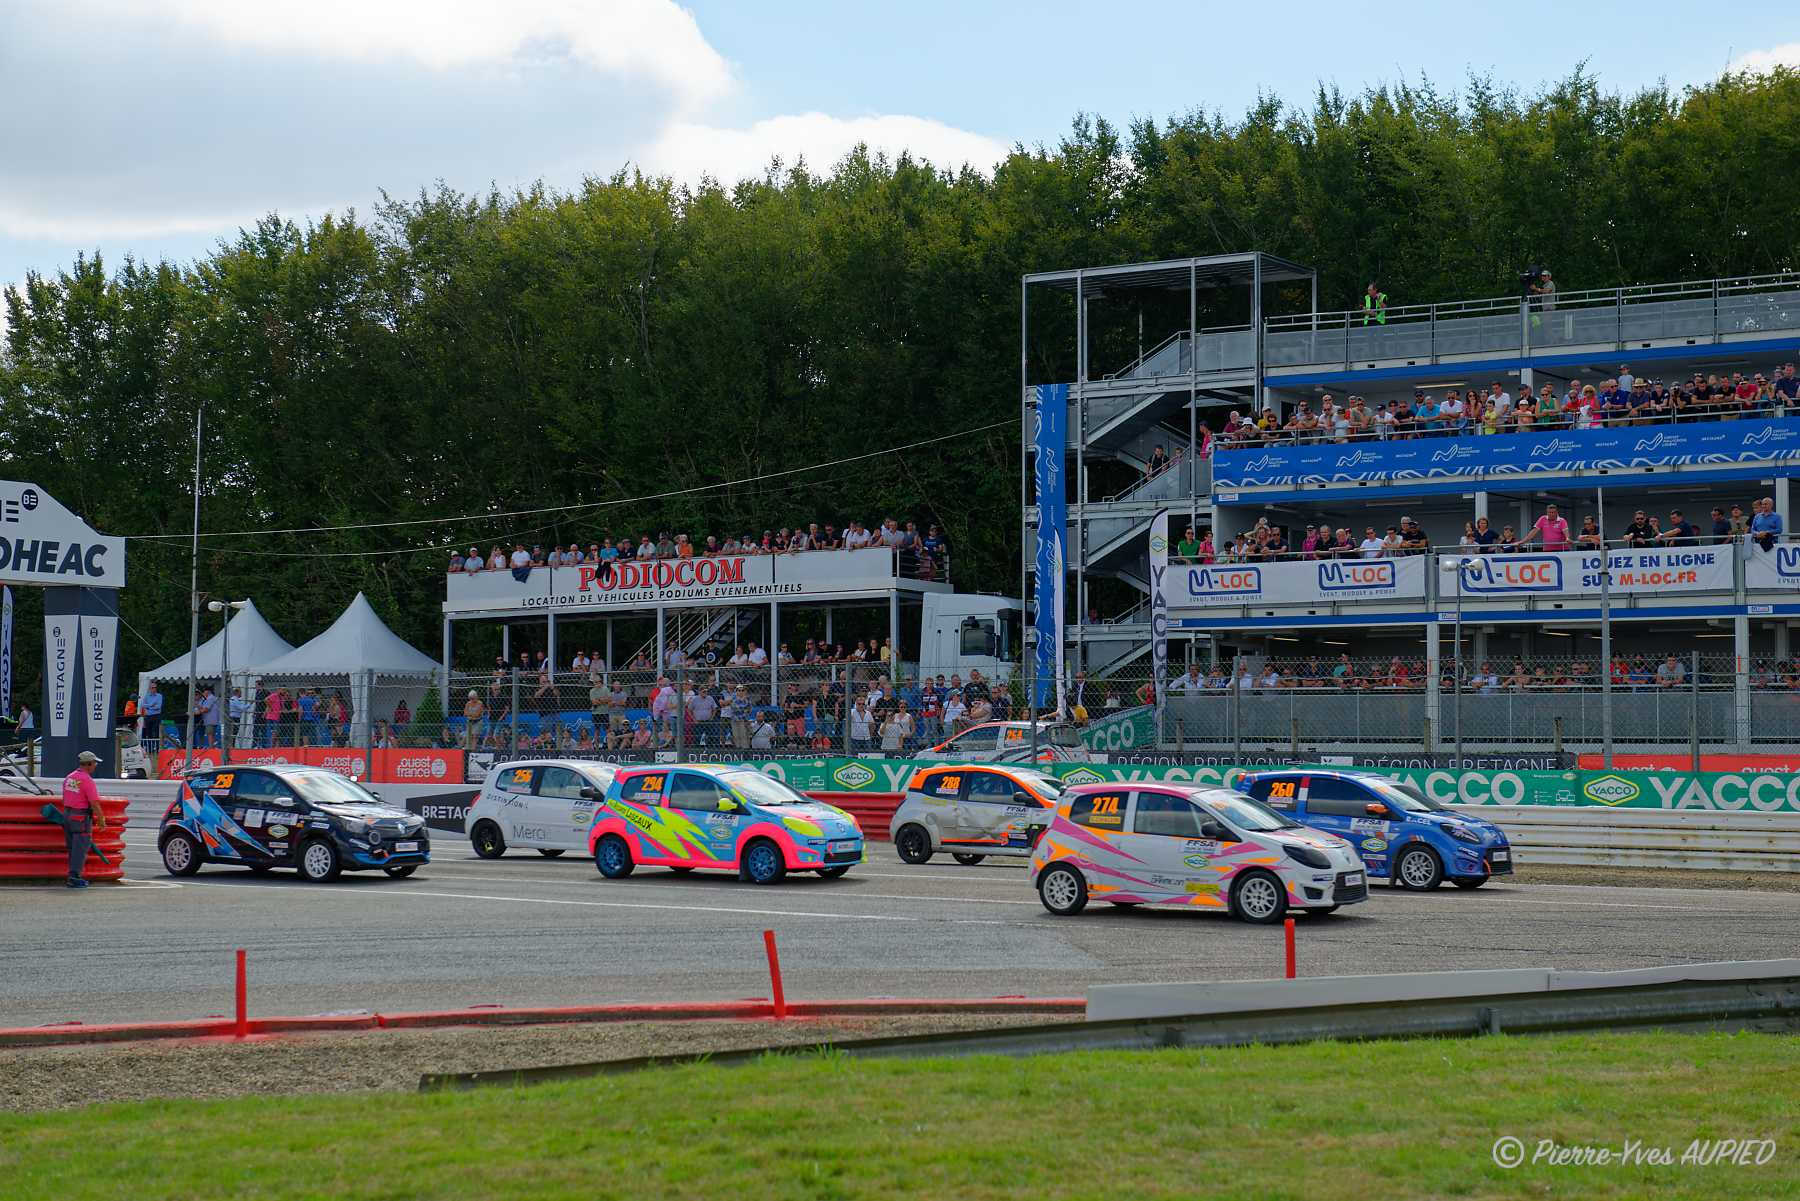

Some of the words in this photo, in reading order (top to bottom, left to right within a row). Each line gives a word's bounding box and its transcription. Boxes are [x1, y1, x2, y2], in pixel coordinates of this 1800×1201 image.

[1582, 556, 1633, 570] LOUEZ
[1639, 555, 1660, 568] EN
[1667, 553, 1715, 567] LIGNE
[577, 558, 745, 592] PODIOCOM
[1189, 568, 1254, 589] M-LOC
[1318, 561, 1389, 584] M-LOC
[1582, 574, 1613, 587] SUR
[1619, 571, 1697, 586] M-LOC.FR
[522, 595, 575, 607] LOCATION
[580, 594, 593, 603] DE
[597, 591, 654, 602] VEHICULES
[659, 588, 709, 599] PODIUMS
[715, 583, 802, 596] EVENEMENTIELS
[56, 638, 66, 720] BRETAGNE
[93, 639, 104, 721] BRETAGNE
[401, 756, 430, 767] ouest
[397, 765, 430, 777] france
[840, 771, 869, 780] YACCO
[1393, 772, 1525, 806] ACCO
[1592, 785, 1632, 796] YACCO
[1092, 797, 1119, 814] 274
[1186, 840, 1214, 848] FFSA
